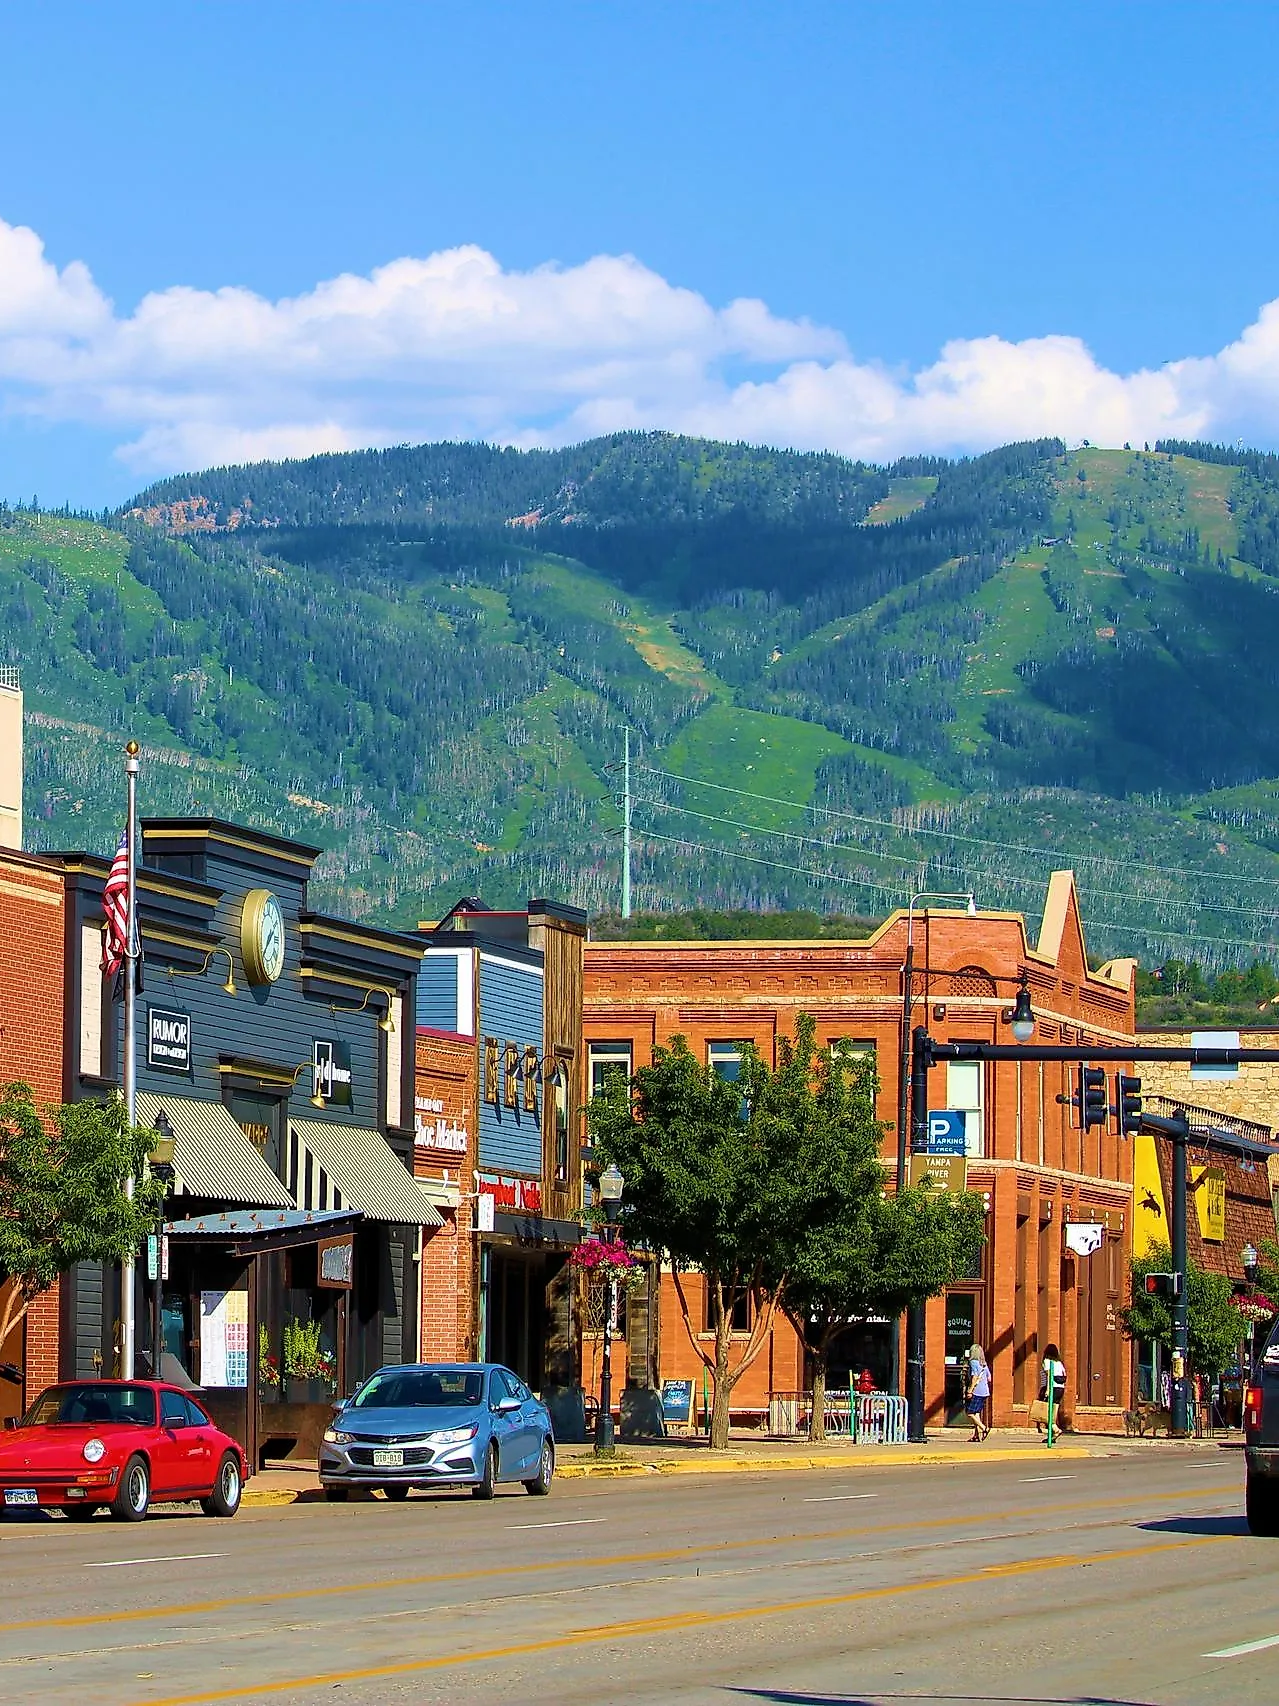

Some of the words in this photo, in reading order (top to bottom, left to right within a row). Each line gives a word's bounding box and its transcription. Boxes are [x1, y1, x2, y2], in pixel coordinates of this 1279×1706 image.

[153, 1018, 187, 1045] RUMOR
[435, 1118, 468, 1151] Market
[926, 1158, 951, 1167] YAMPA
[927, 1169, 949, 1178] RIVER
[947, 1318, 972, 1328] SQUIRE
